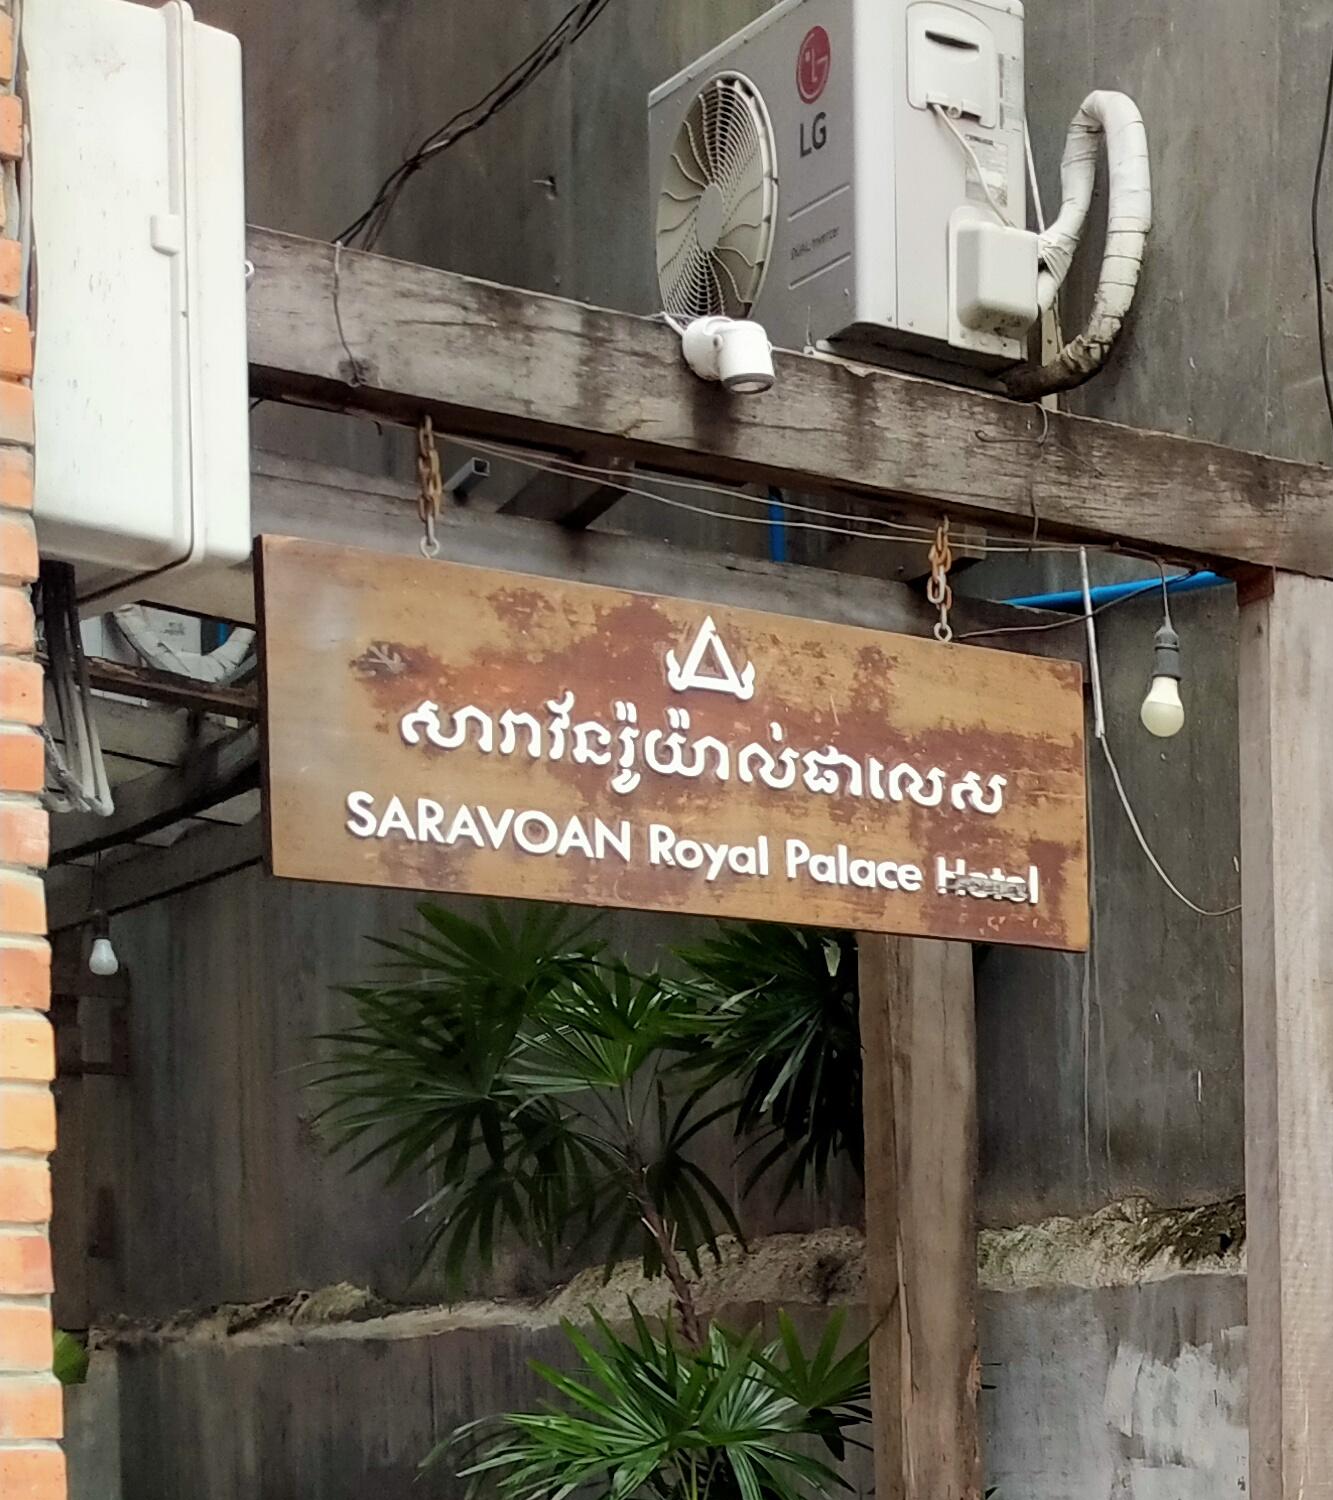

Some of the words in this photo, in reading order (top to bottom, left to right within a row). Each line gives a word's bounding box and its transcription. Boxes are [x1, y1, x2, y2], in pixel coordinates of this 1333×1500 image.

[799, 111, 828, 159] LG
[345, 790, 633, 863] SARAVOAN
[648, 822, 769, 882] Royal
[784, 837, 924, 892] Palace
